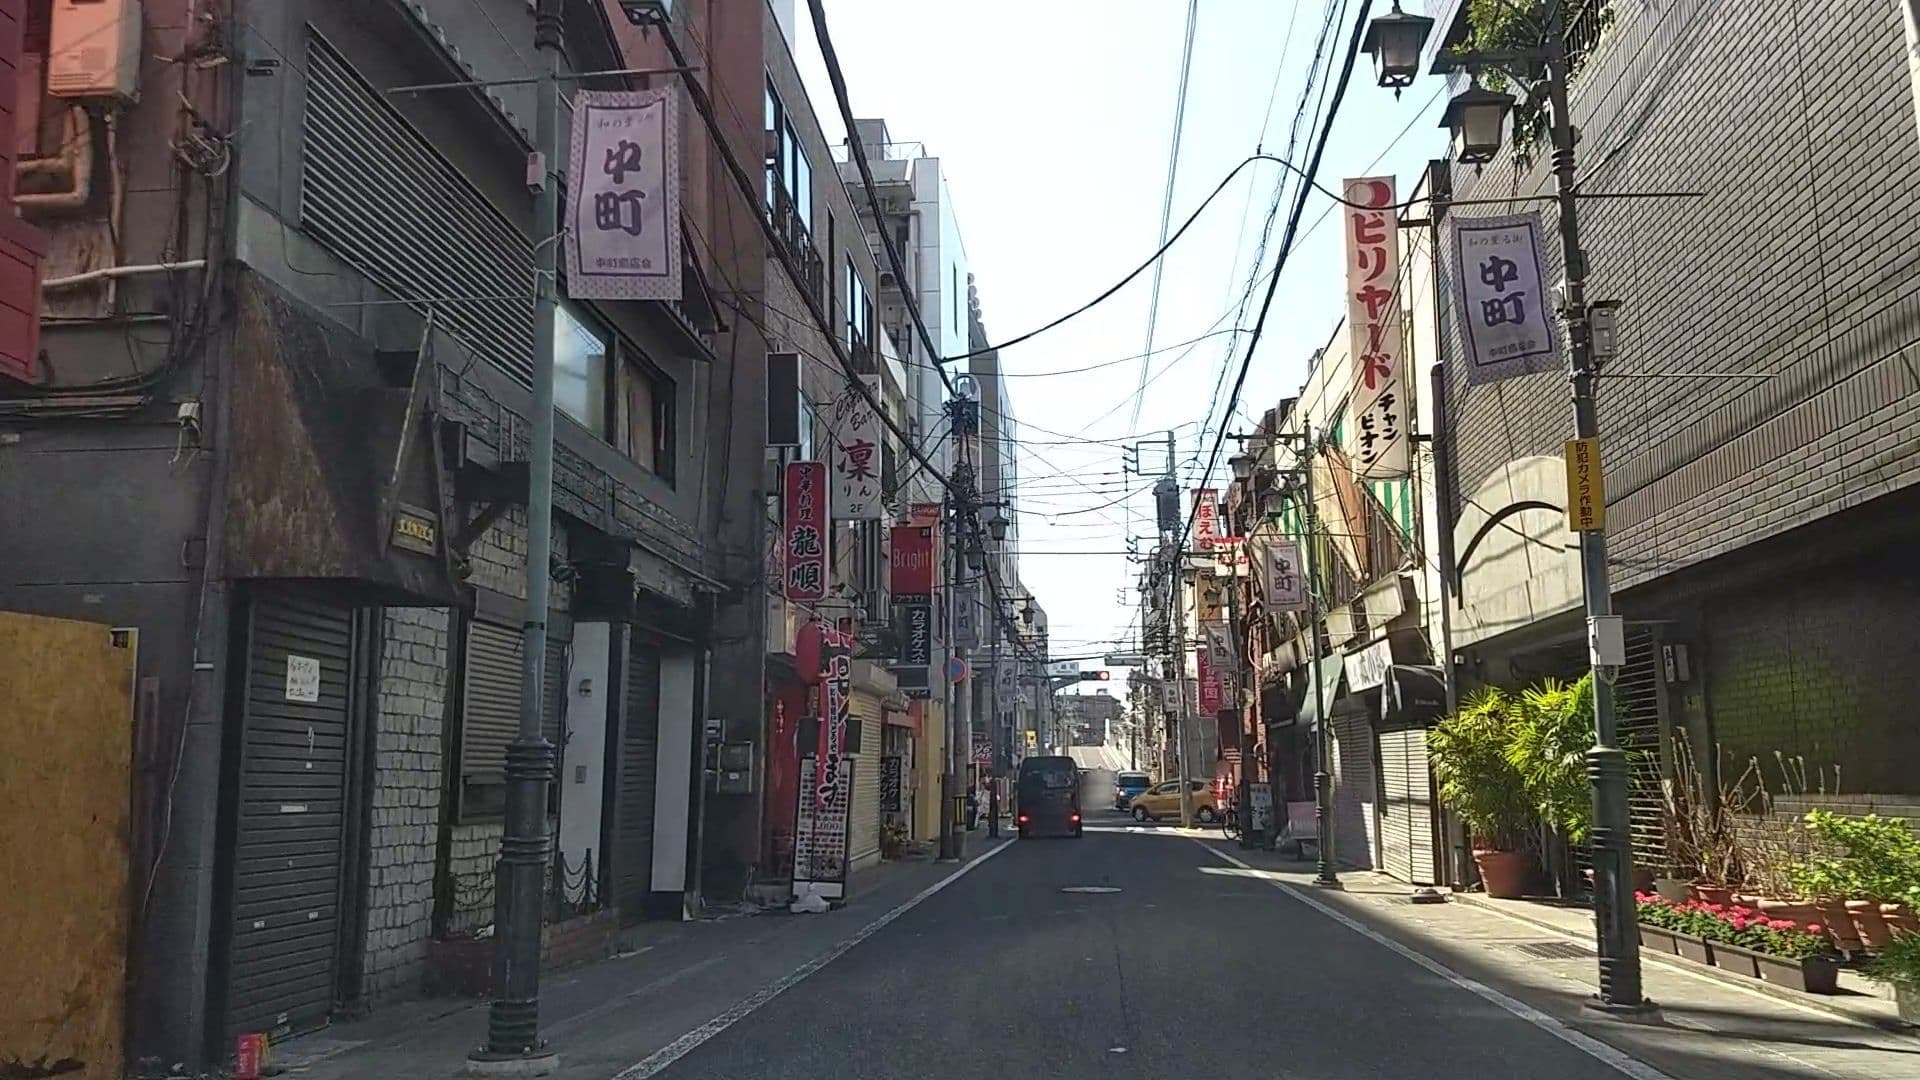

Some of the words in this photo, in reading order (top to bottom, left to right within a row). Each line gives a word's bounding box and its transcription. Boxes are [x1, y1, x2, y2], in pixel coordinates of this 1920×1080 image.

[595, 139, 647, 236] 中町
[1352, 211, 1393, 391] ビリヤード
[1480, 255, 1526, 328] 中町
[1378, 393, 1398, 441] チャン
[843, 485, 871, 497] りん
[850, 504, 863, 513] 2F
[1575, 442, 1594, 528] 防犯カメラ作動中
[789, 525, 822, 592] 龍順
[893, 548, 929, 570] Bright
[1274, 558, 1293, 592] 中町
